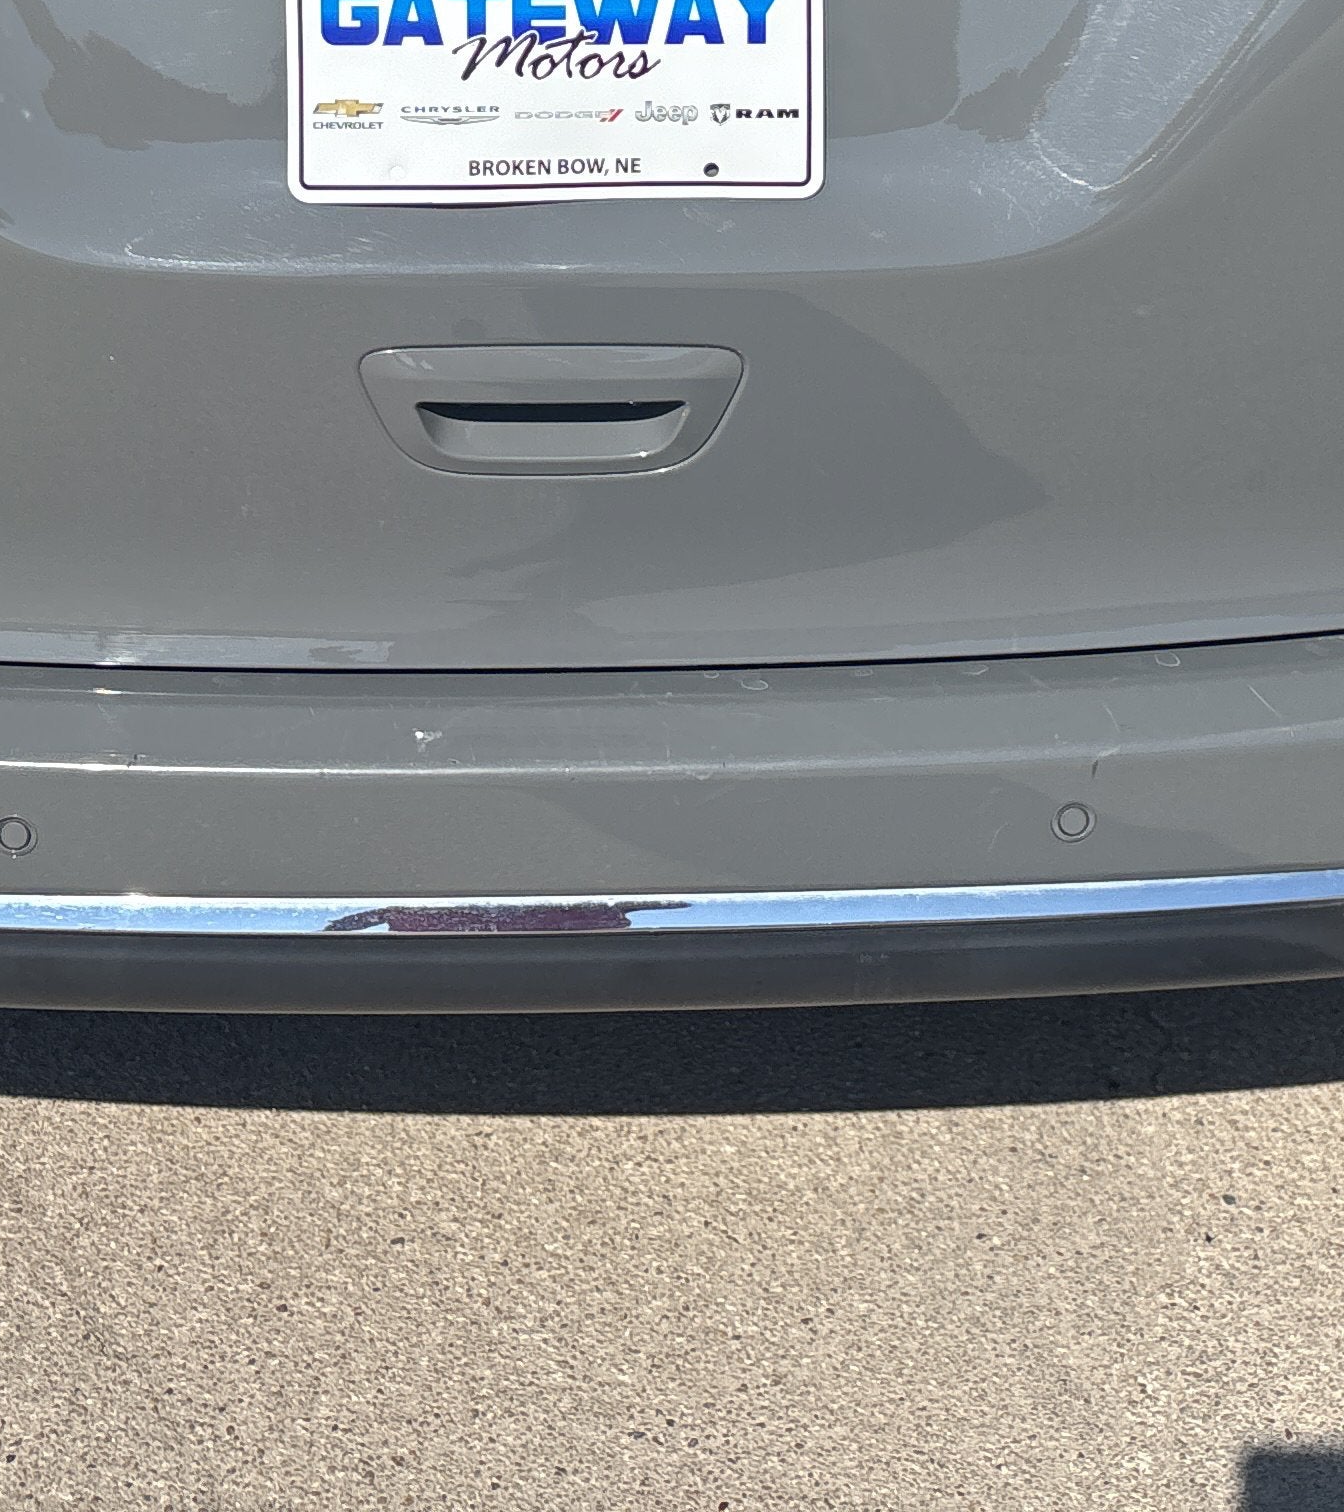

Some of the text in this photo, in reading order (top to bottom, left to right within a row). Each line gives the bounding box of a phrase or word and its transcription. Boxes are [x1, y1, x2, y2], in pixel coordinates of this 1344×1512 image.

[452, 28, 662, 82] Motors
[400, 104, 501, 115] CHRYSLER
[514, 109, 610, 121] DODGE
[634, 99, 699, 126] Jeep
[735, 108, 801, 120] RAM
[312, 121, 385, 130] CHEVROLET
[468, 157, 642, 179] BROKEN BOW, NE
